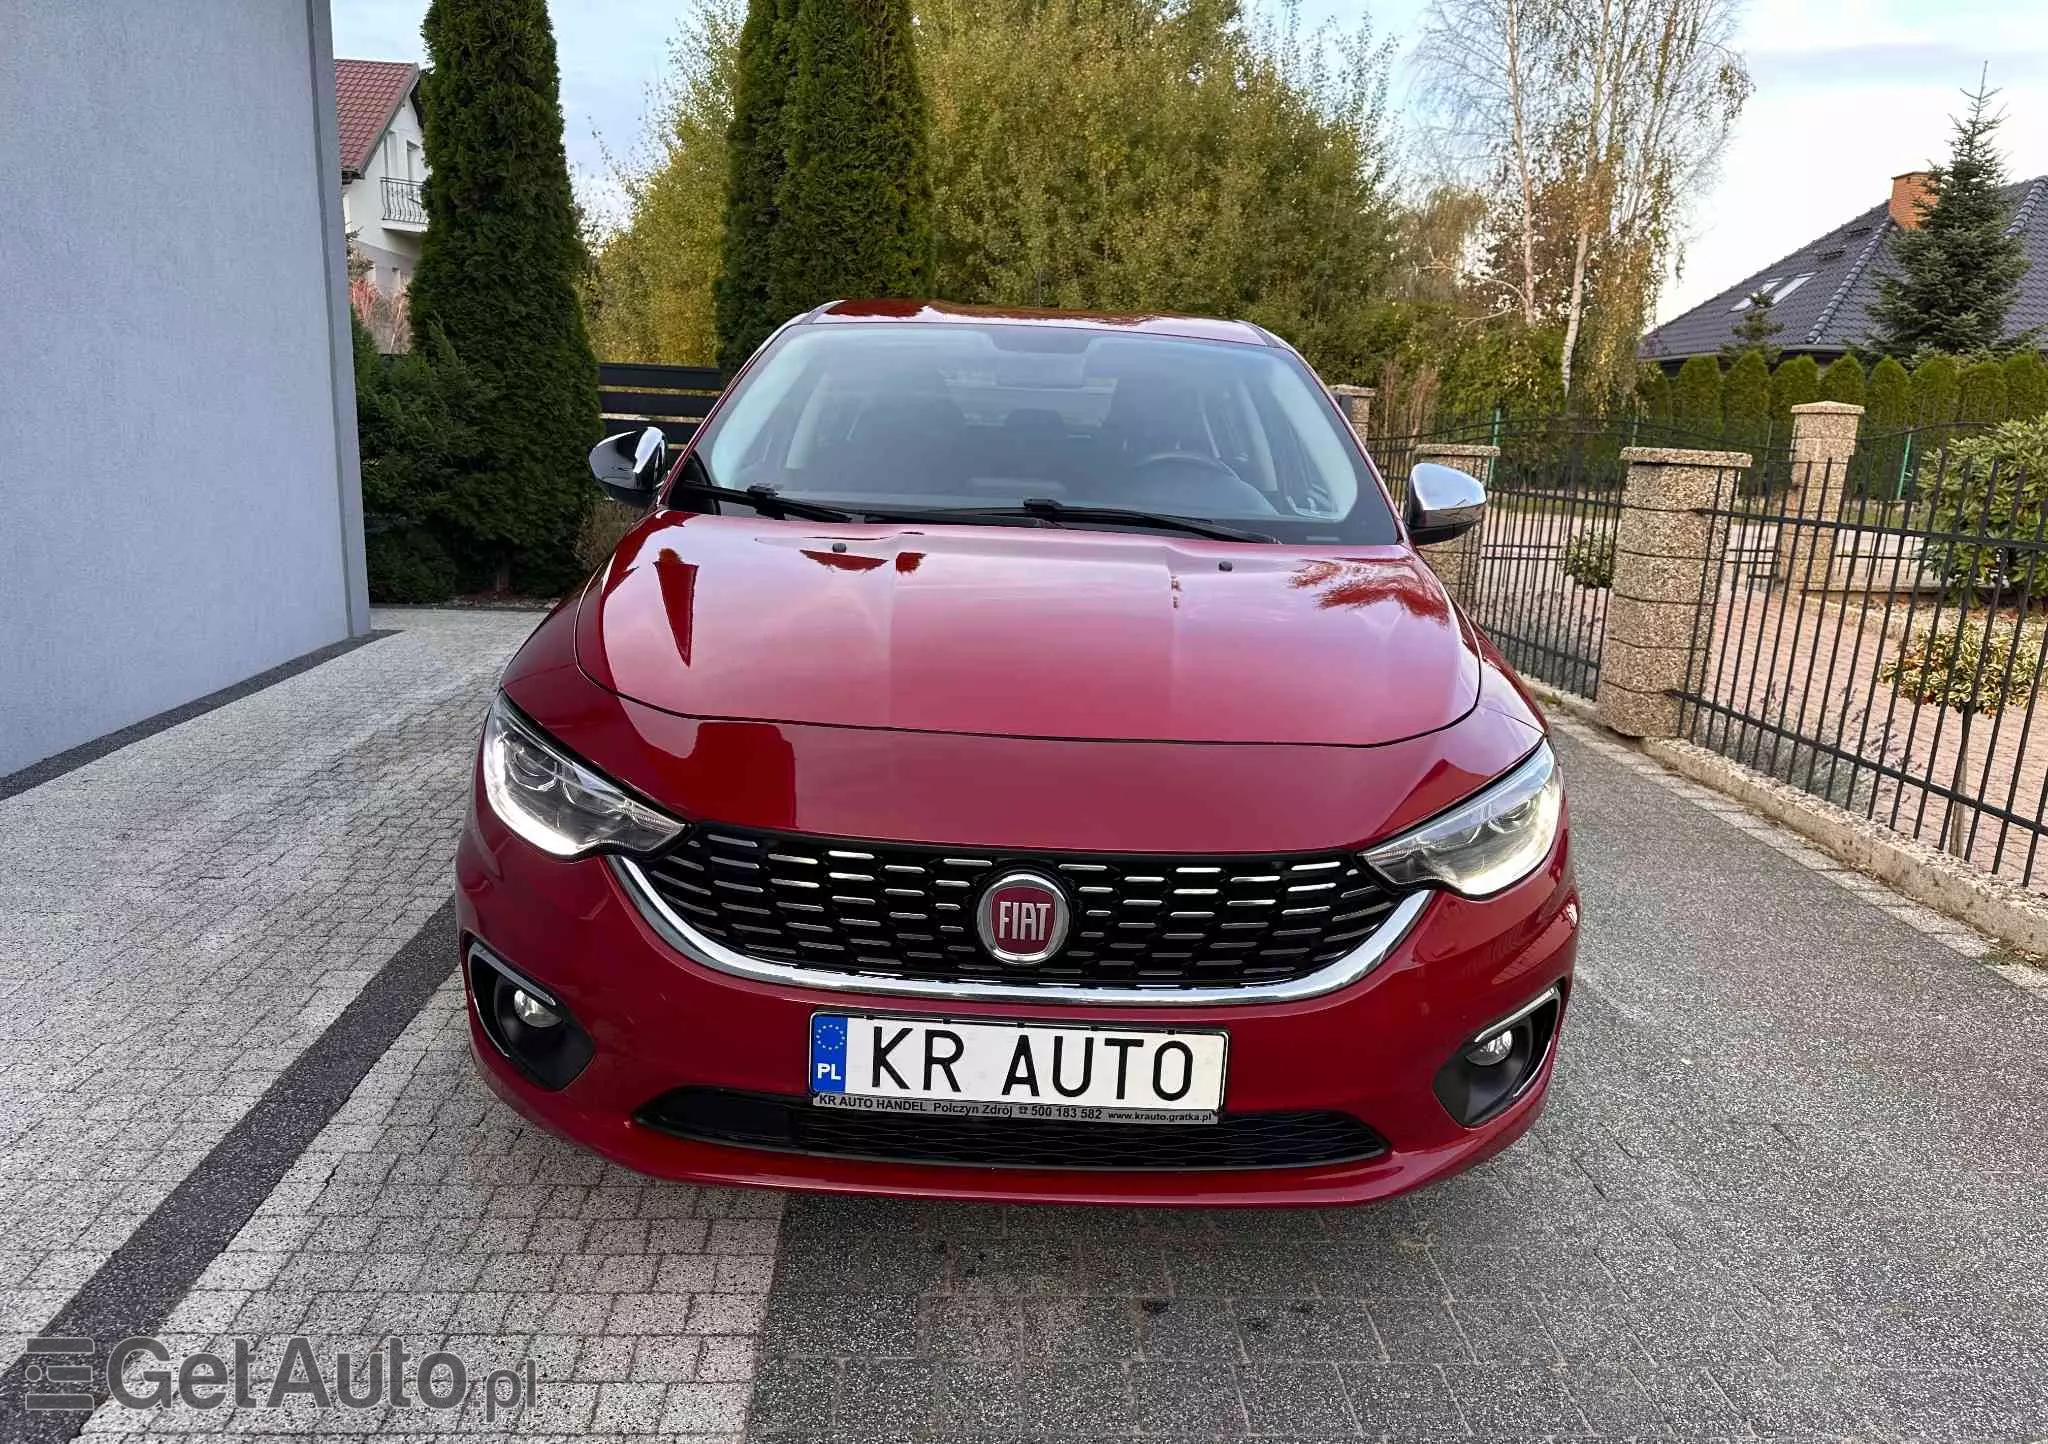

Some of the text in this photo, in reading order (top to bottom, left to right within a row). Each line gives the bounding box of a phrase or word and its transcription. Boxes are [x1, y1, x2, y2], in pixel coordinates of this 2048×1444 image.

[999, 902, 1051, 940] FIAT
[817, 1062, 842, 1081] PL
[871, 1026, 1194, 1101] KR AUTO
[819, 1095, 836, 1106] KR
[839, 1096, 873, 1109] AUTO
[877, 1099, 927, 1112] HANDEL
[983, 1104, 1013, 1118] Zdrój
[1031, 1106, 1052, 1117] 500
[1056, 1107, 1077, 1119] 183
[1080, 1108, 1103, 1120] 582
[1108, 1111, 1212, 1123] www.krauto.gratka.pl
